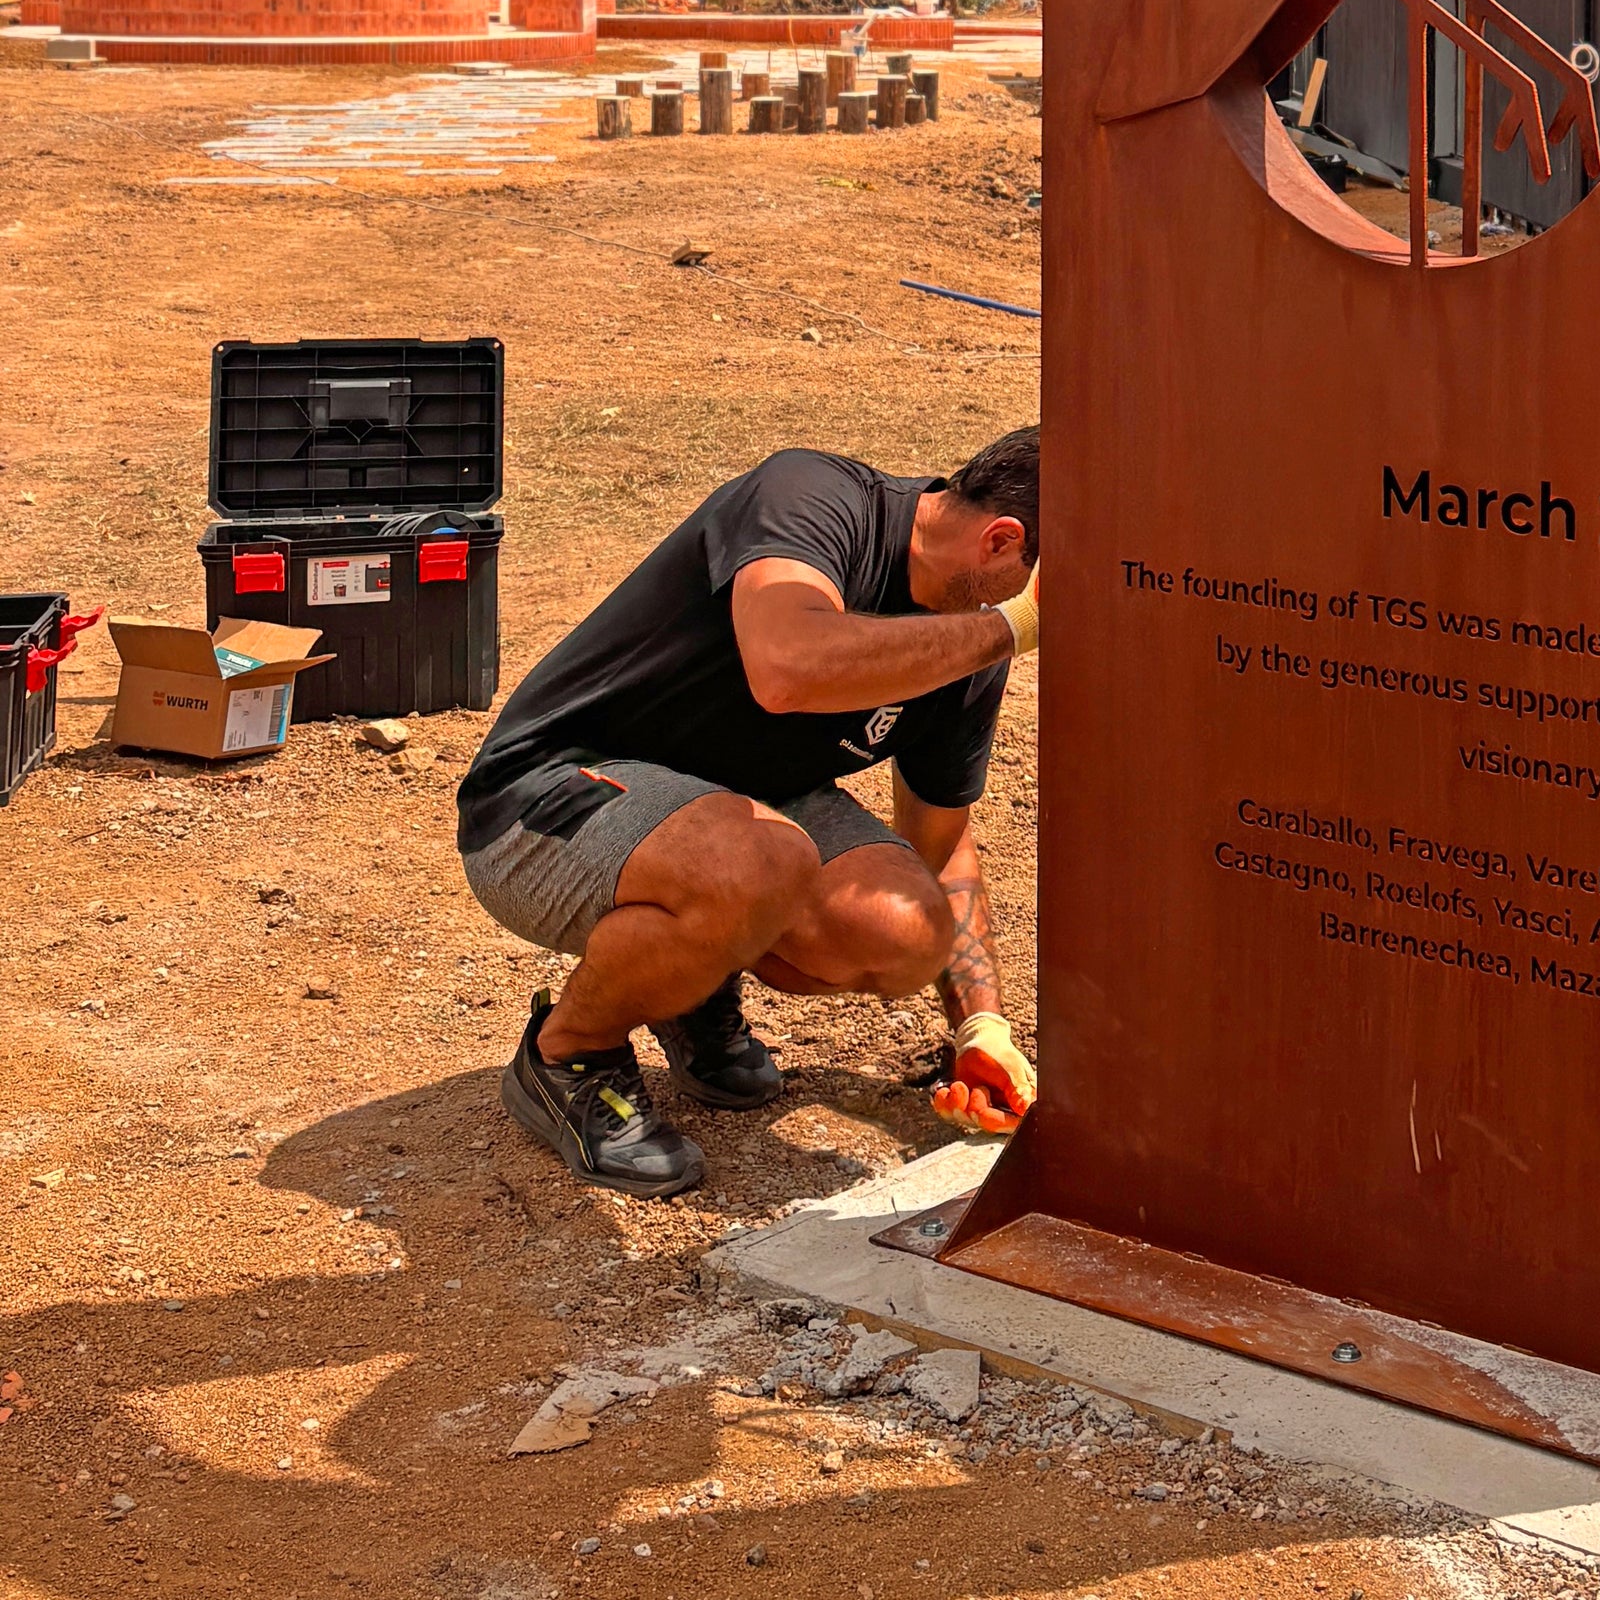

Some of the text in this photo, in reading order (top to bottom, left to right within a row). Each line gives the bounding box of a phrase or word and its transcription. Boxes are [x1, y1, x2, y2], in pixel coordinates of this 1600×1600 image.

[1382, 465, 1576, 541] March
[1120, 560, 1174, 593] The
[1182, 567, 1318, 621] founding
[1328, 590, 1360, 620] of
[1366, 594, 1428, 630] TGS
[1437, 610, 1501, 641] was
[166, 695, 208, 711] WURTH
[1217, 634, 1253, 674] by
[1260, 643, 1311, 677] the
[1319, 659, 1469, 702] generous
[1237, 798, 1379, 855] Caraballo,
[1388, 827, 1517, 882] Fravega,
[1214, 841, 1356, 899] Castagno,
[1366, 871, 1483, 926] Roelofs,
[1493, 897, 1579, 946] Yasci,
[1320, 911, 1520, 985] Barrenechea,
